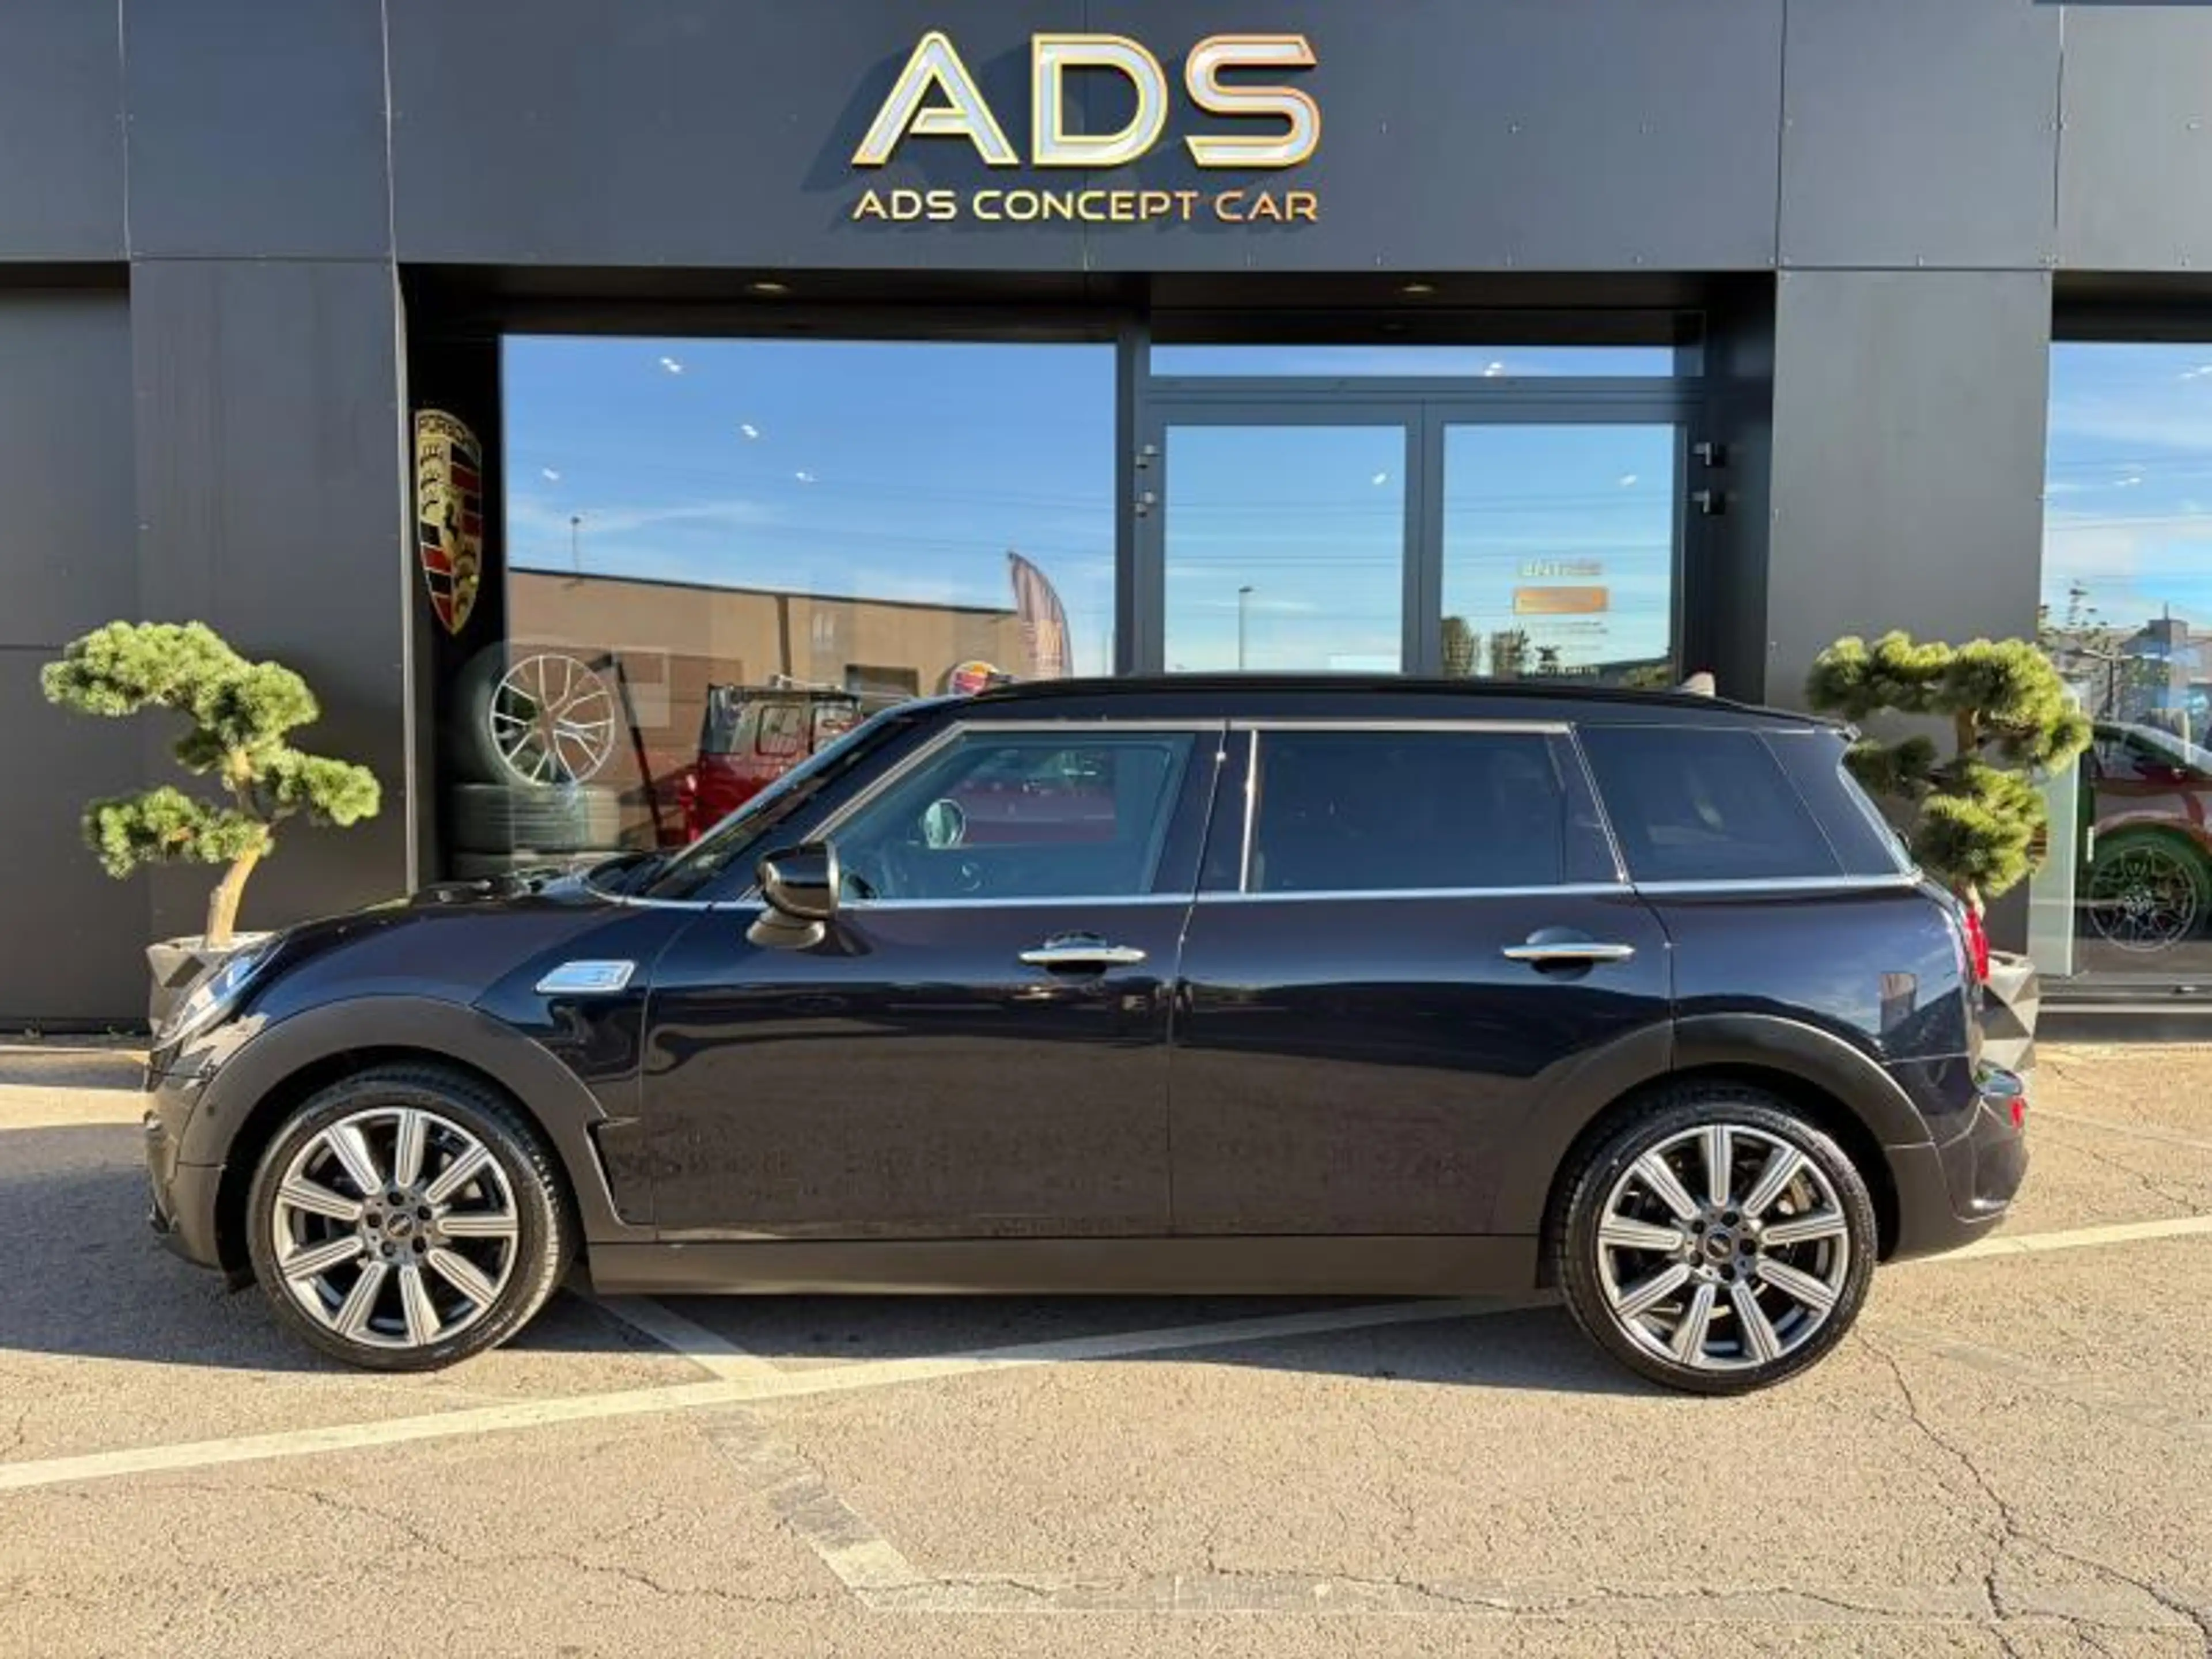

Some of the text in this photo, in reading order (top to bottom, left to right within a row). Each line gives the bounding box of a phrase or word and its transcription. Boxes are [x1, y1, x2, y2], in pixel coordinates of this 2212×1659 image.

[851, 31, 1321, 166] ADS
[854, 190, 1319, 222] ADS CONCEPT CAR
